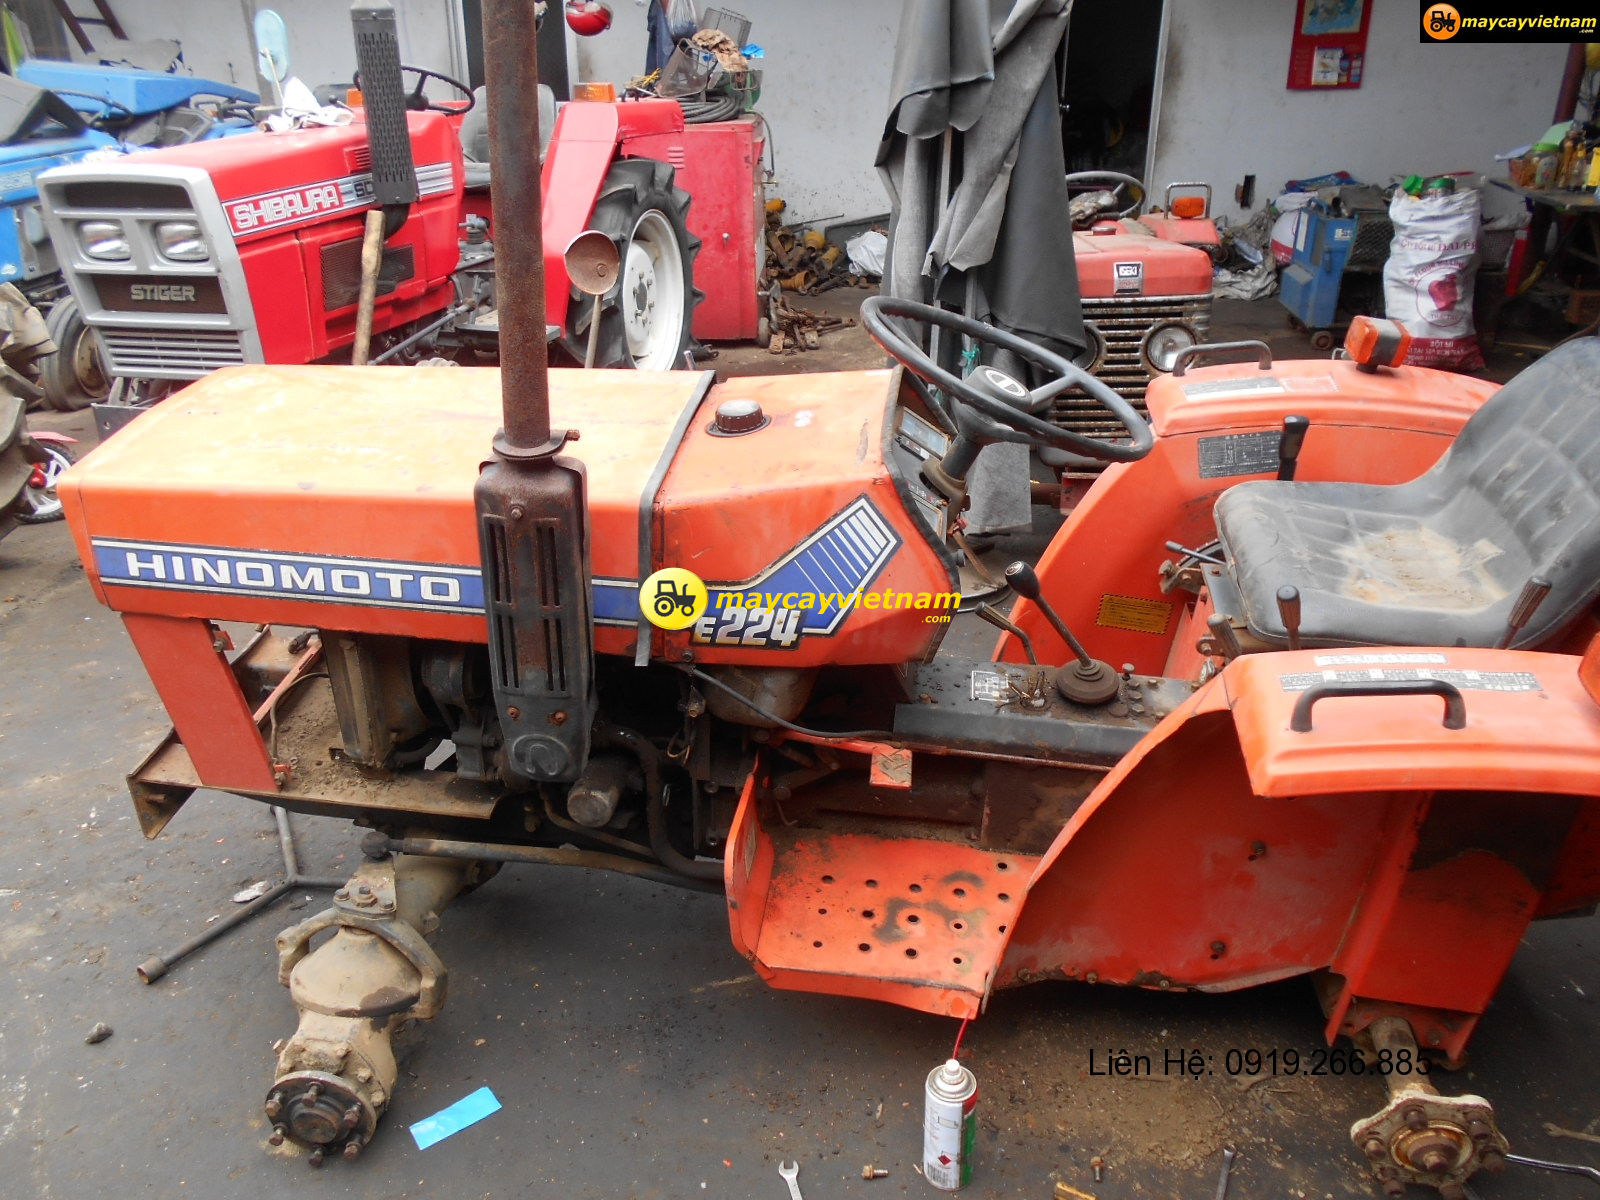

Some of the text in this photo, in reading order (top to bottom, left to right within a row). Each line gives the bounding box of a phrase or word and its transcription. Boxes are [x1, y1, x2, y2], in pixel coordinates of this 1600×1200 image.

[232, 185, 340, 229] SHIBAURA
[131, 284, 196, 302] STIGER
[126, 551, 461, 603] HINOMOTO
